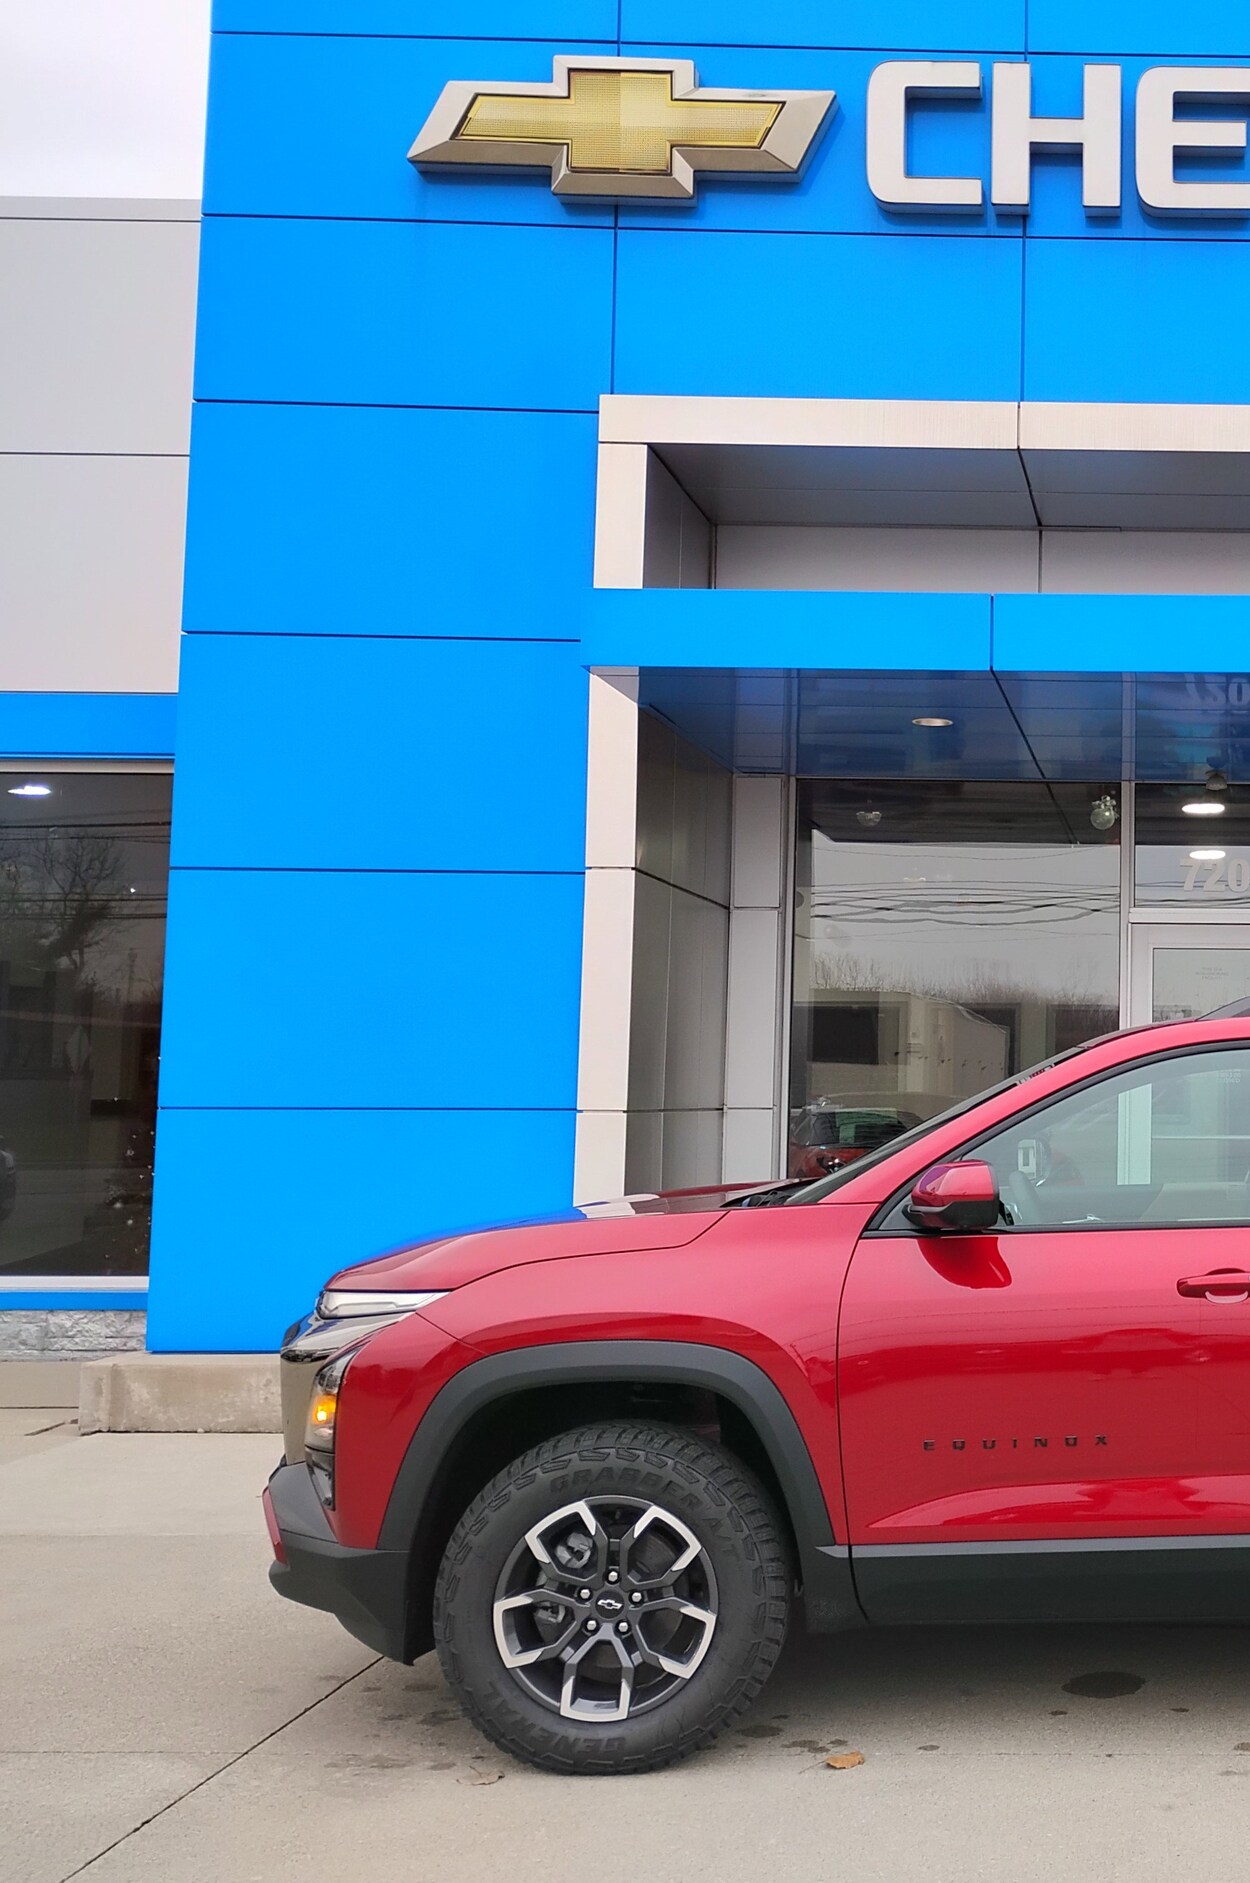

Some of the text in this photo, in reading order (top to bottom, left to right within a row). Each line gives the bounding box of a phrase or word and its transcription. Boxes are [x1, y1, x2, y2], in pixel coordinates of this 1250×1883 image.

[1179, 858, 1250, 893] 720
[923, 1434, 1108, 1451] EQUINOX
[549, 1466, 703, 1511] GRABBER
[482, 1679, 628, 1755] GENERAL
